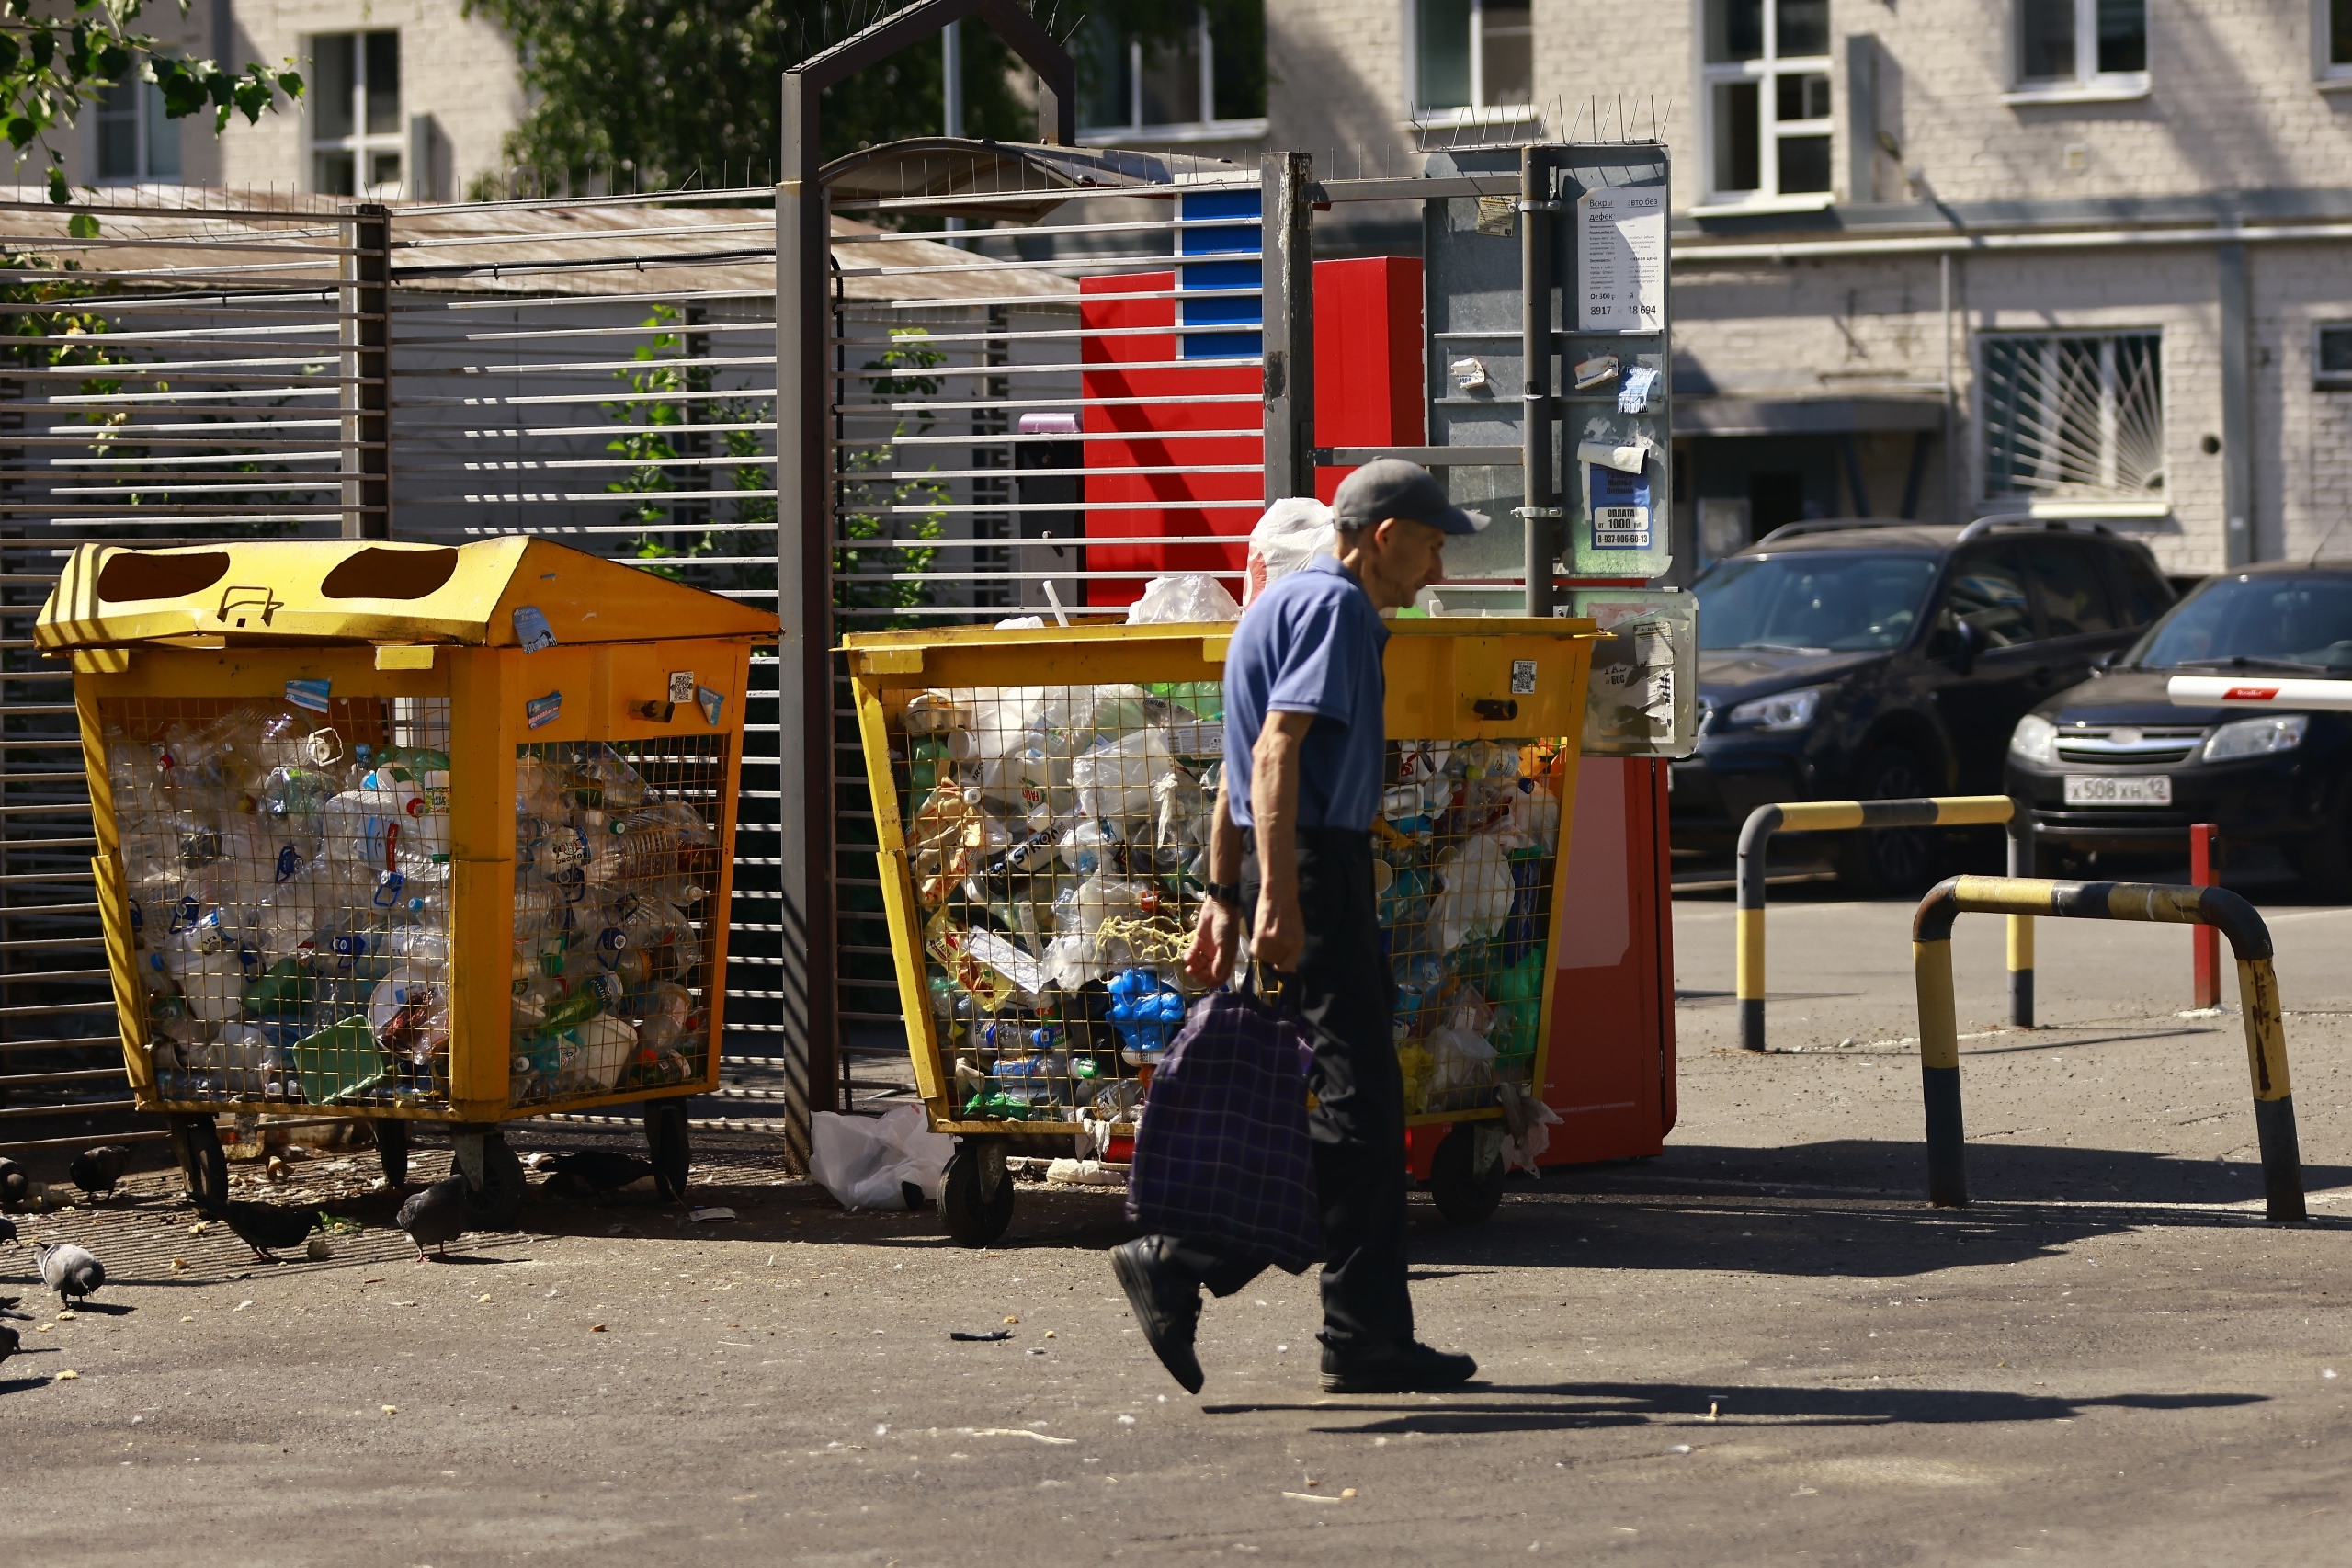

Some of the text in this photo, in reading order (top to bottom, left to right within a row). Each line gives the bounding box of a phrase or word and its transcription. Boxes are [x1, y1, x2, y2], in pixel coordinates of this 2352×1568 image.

[1589, 199, 1614, 208] Вскры
[1644, 197, 1658, 206] без
[1589, 211, 1615, 222] дефек
[1590, 306, 1612, 315] 8917
[1640, 305, 1656, 315] 694
[1608, 509, 1635, 517] ОПЛАТА
[1608, 518, 1630, 528] 1000
[1597, 534, 1648, 543] 8-937-006-60-13
